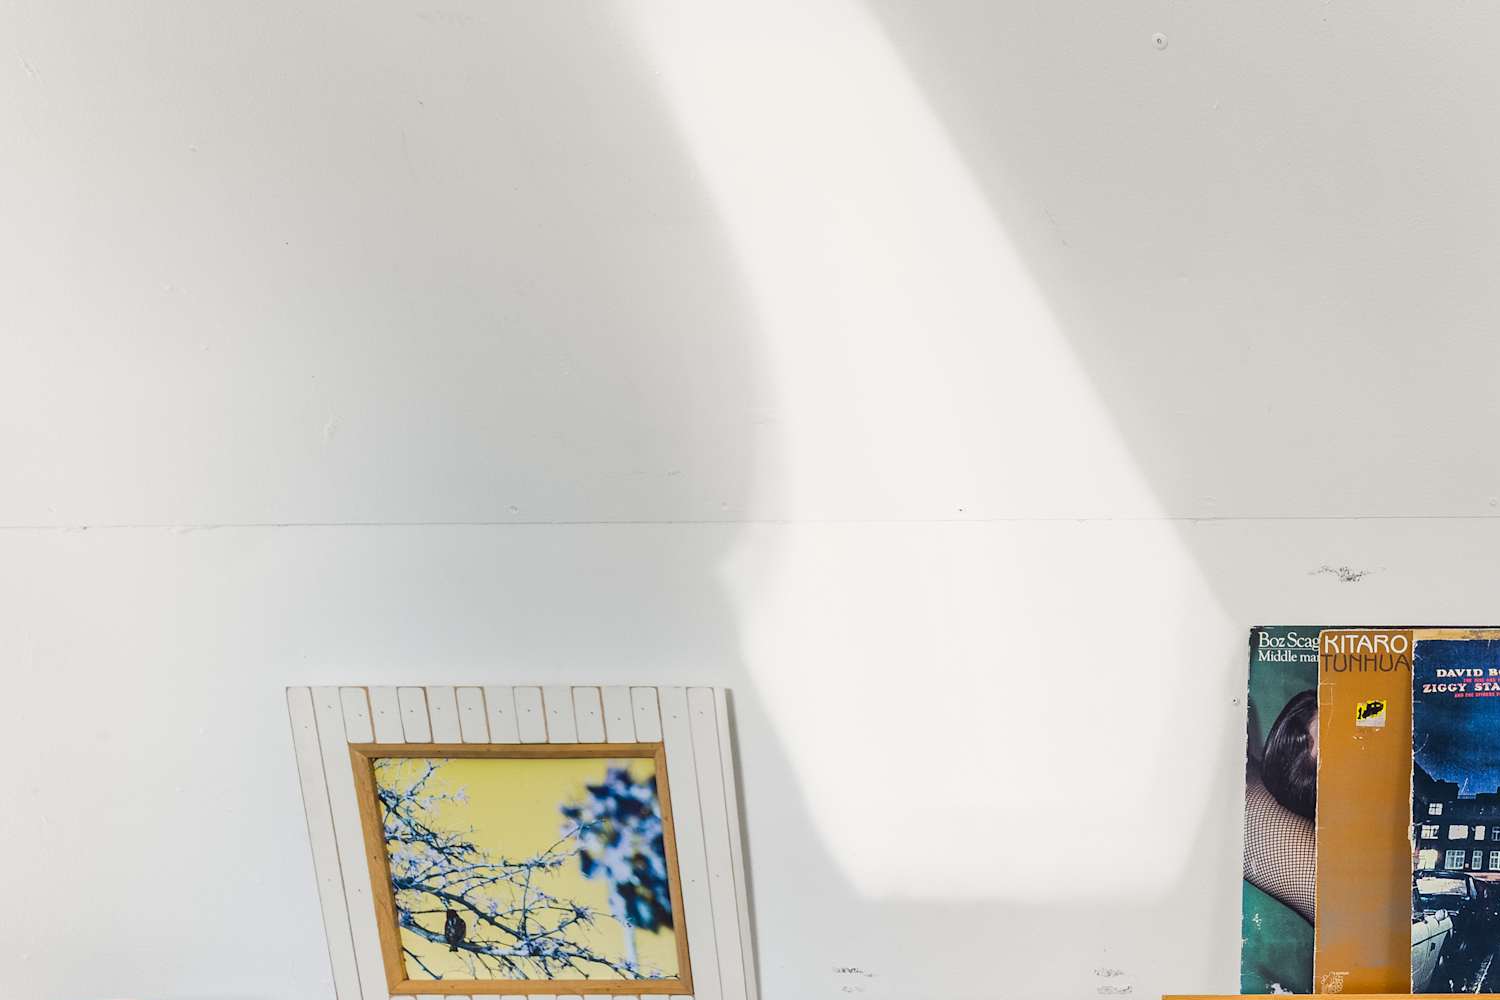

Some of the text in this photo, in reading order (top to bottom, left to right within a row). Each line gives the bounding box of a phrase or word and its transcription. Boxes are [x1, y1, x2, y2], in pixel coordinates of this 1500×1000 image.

[1258, 632, 1285, 648] Boz
[1324, 634, 1408, 654] KITARO
[1258, 650, 1297, 662] Middle
[1436, 668, 1484, 678] DAVID
[1422, 683, 1467, 694] ZIGGY
